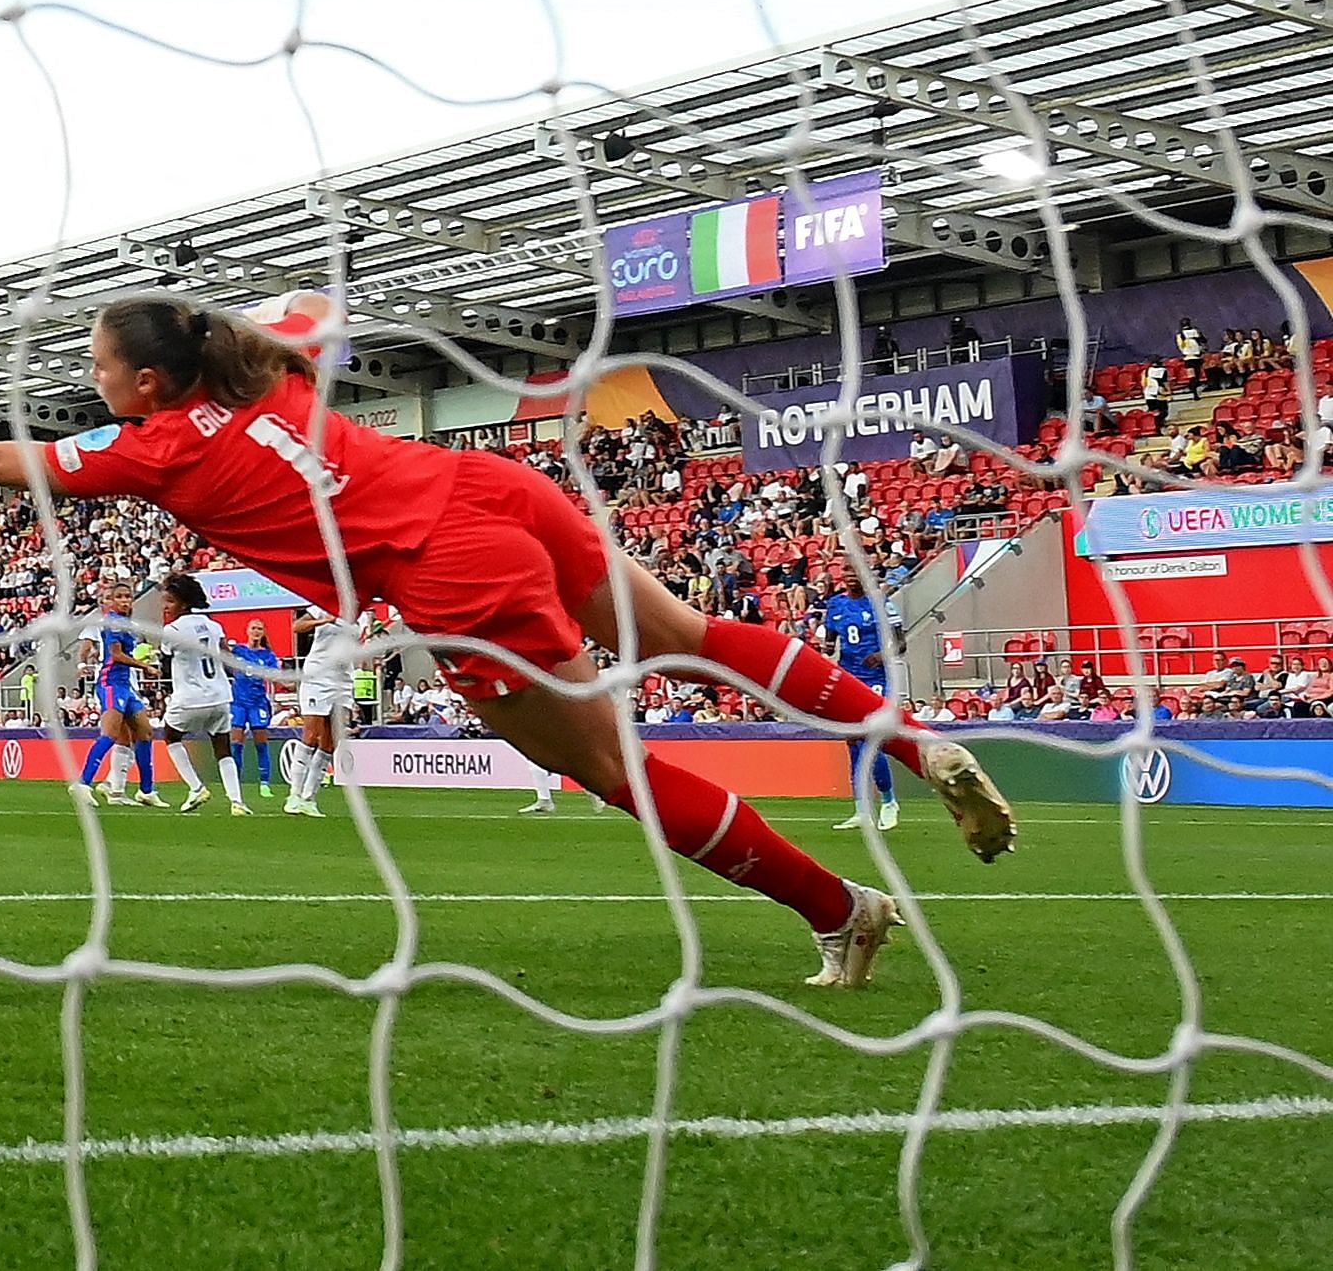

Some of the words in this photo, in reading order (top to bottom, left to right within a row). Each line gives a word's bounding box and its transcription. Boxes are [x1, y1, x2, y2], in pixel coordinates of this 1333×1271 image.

[1168, 508, 1226, 532] UEFA
[847, 625, 860, 644] 8
[393, 753, 492, 775] ROTHERHAM
